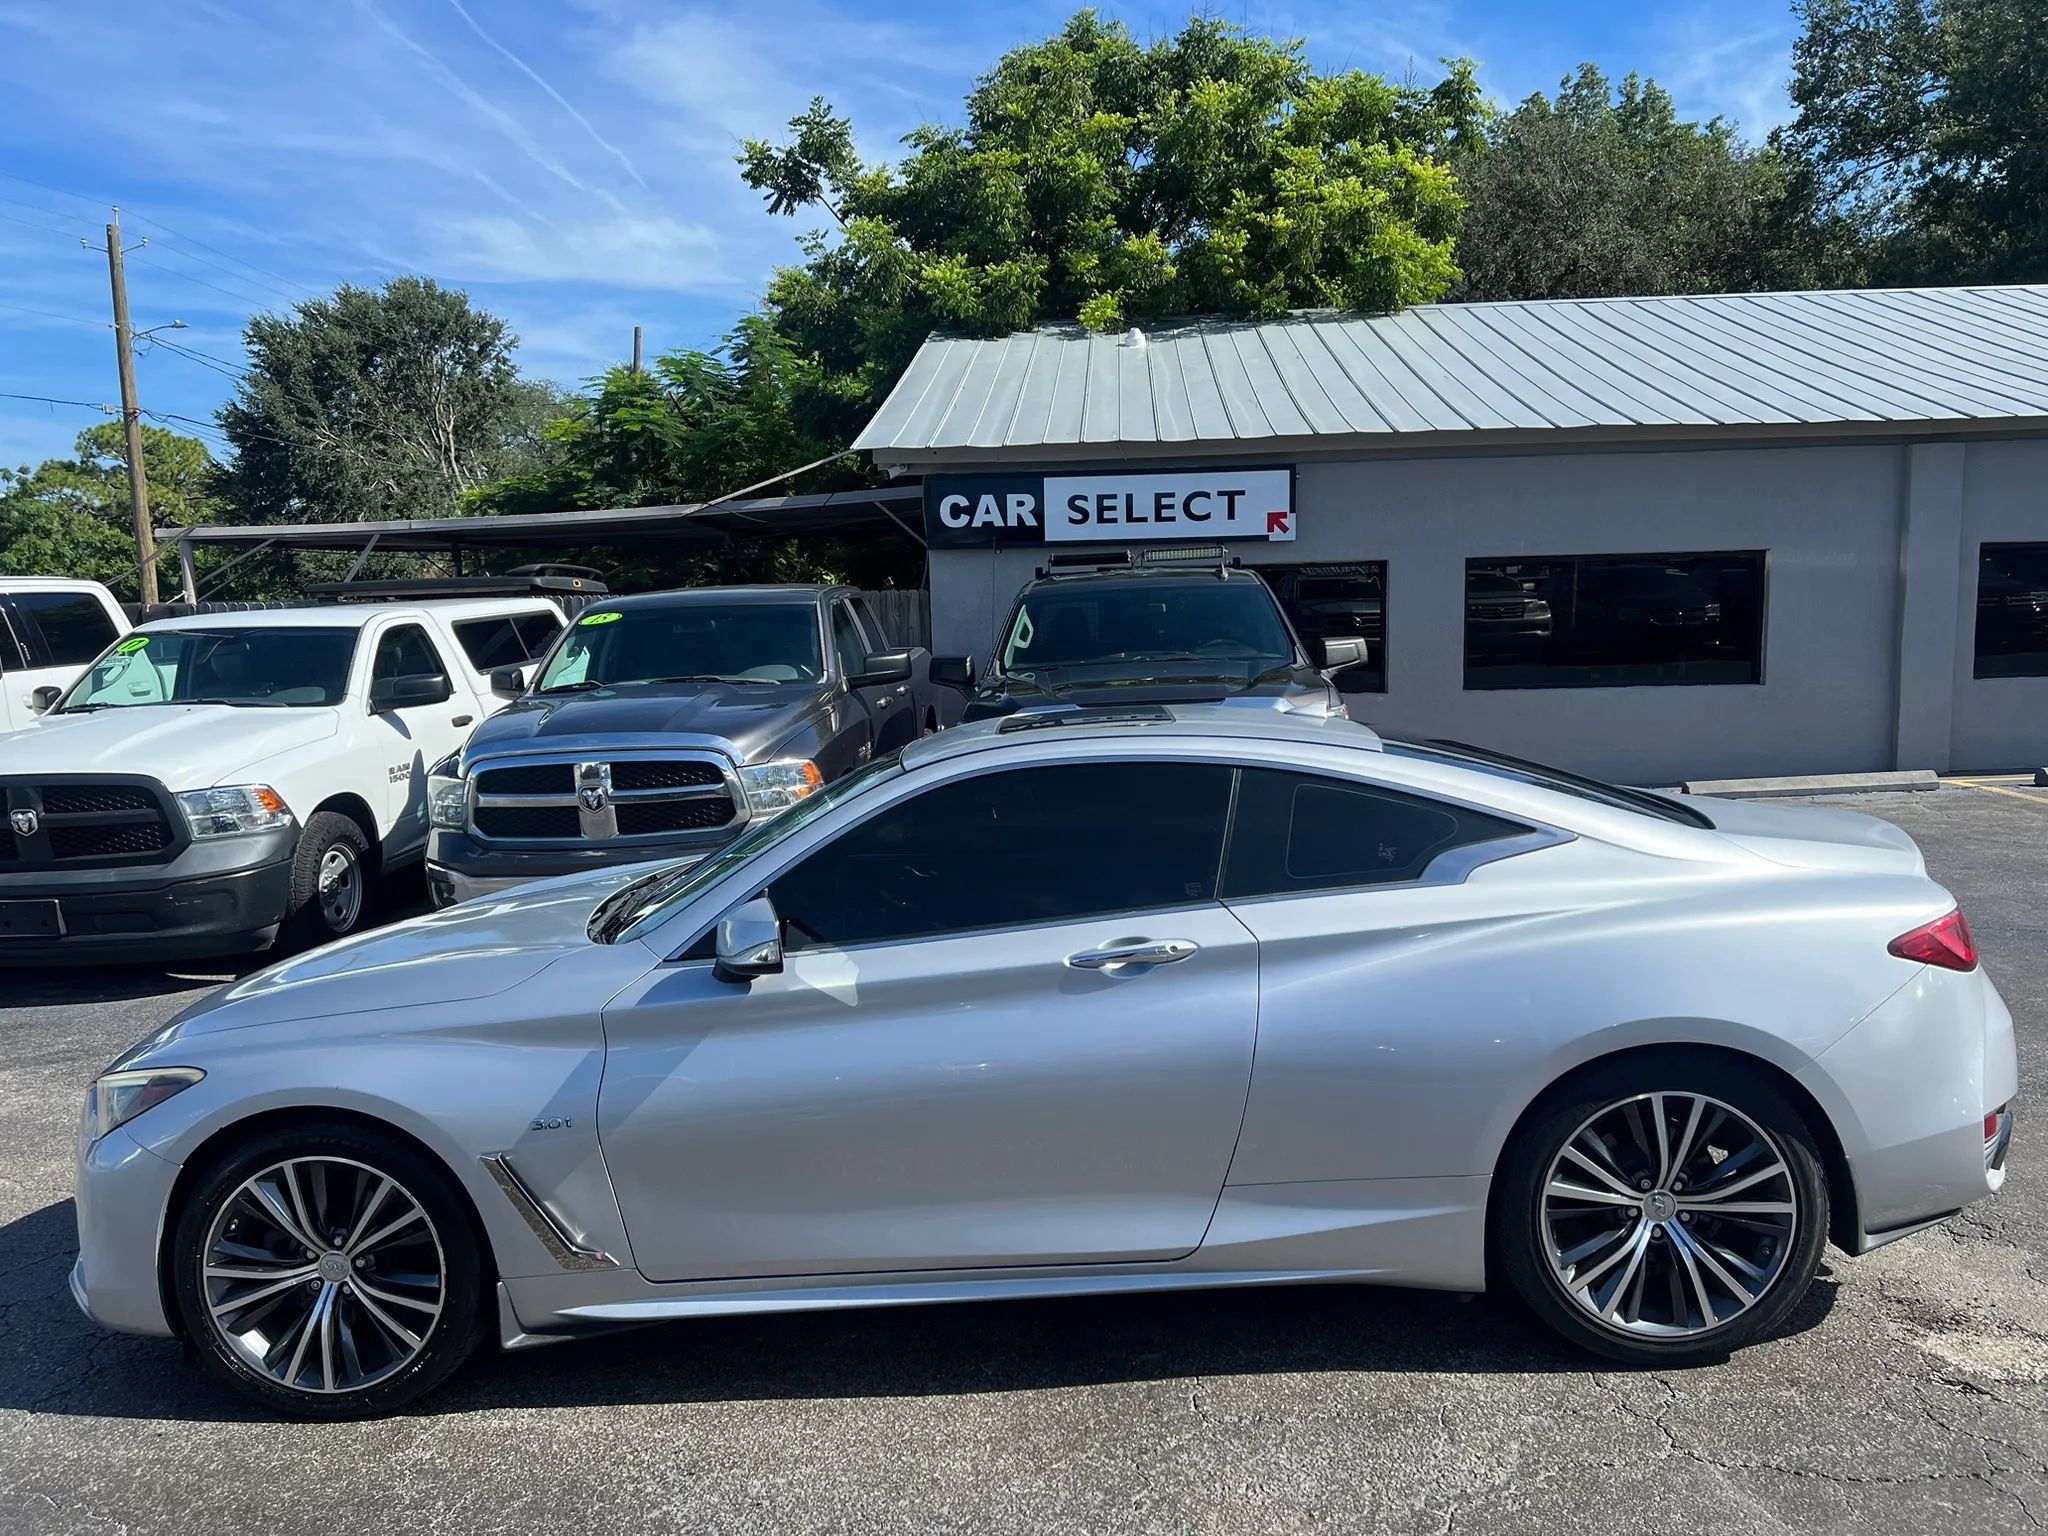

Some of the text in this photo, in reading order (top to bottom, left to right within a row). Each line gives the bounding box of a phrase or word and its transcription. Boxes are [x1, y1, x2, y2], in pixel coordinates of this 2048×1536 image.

[939, 489, 1246, 528] CAR SELECT
[388, 762, 410, 775] RAM
